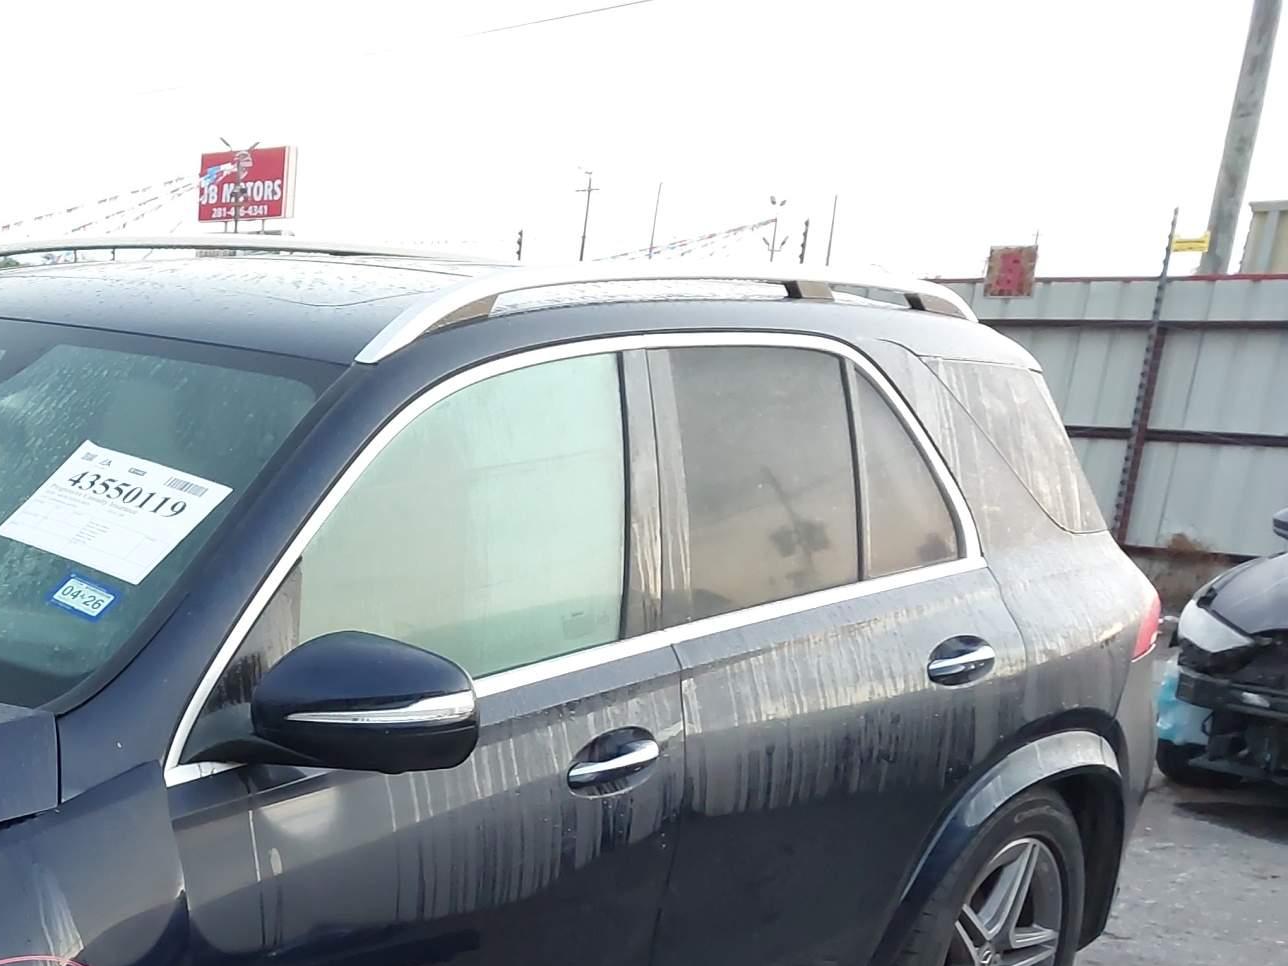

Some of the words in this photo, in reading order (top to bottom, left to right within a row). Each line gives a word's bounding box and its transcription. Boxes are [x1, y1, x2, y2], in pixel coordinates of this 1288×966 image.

[200, 184, 218, 205] JB
[222, 180, 282, 203] MTORS
[212, 206, 268, 217] 281-46-4341
[67, 471, 188, 518] 43550119
[61, 585, 82, 600] 04
[82, 595, 105, 610] 26
